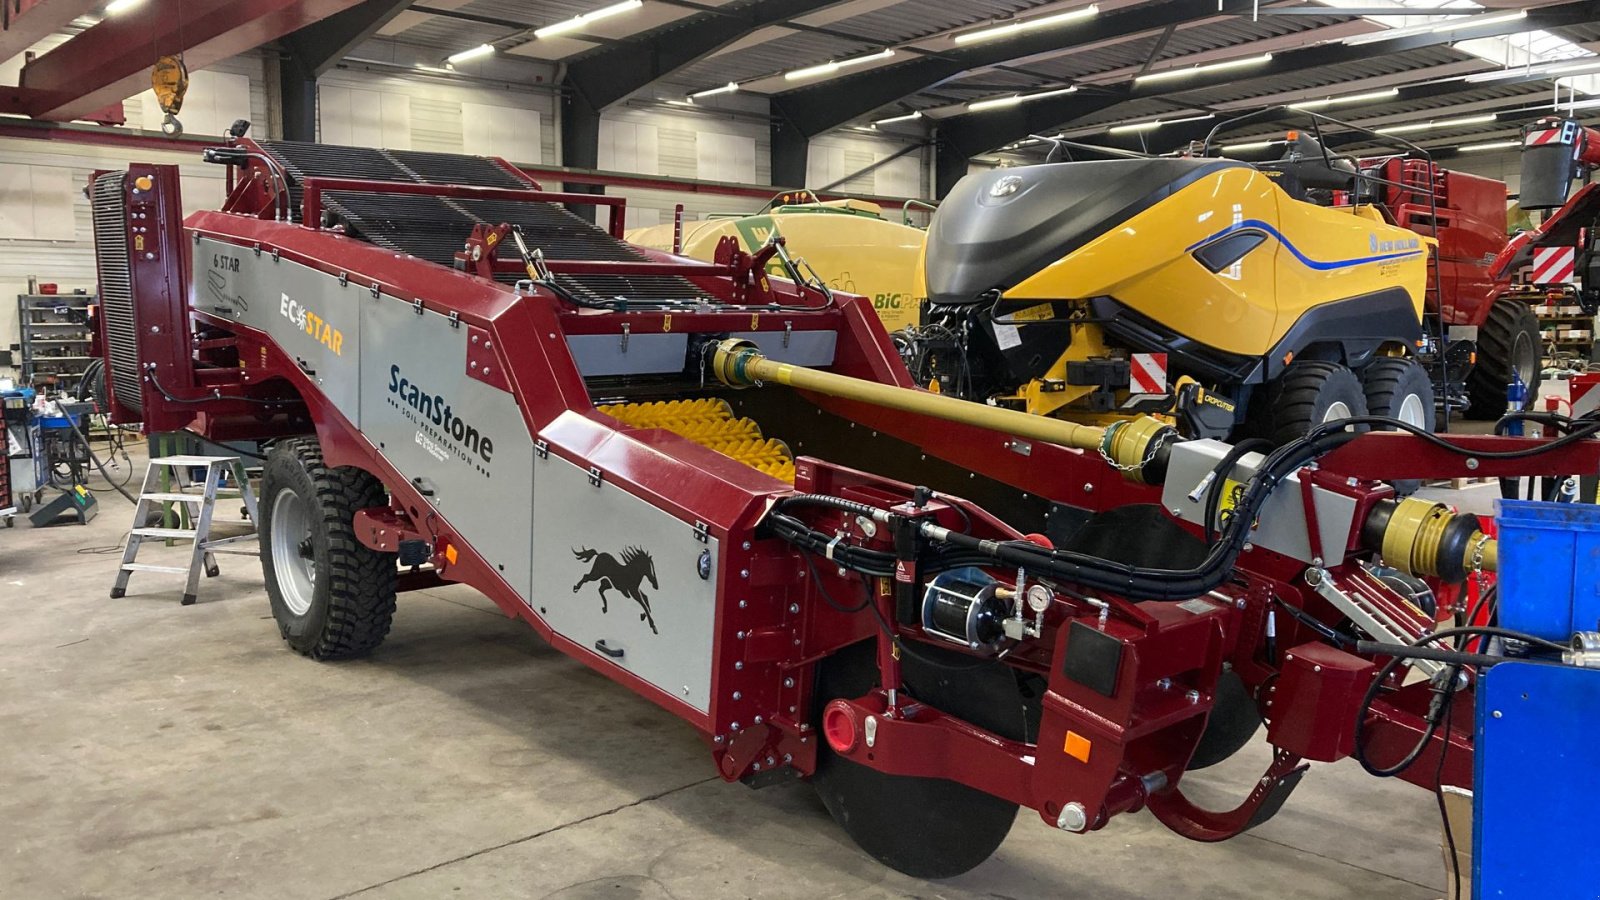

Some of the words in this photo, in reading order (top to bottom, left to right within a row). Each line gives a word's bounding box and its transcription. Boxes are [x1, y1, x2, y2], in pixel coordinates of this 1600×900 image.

[213, 253, 219, 268] 6
[220, 256, 240, 273] STAR
[389, 364, 494, 463] ScanStone
[401, 408, 418, 424] SOIL
[420, 421, 473, 466] PREPARATION
